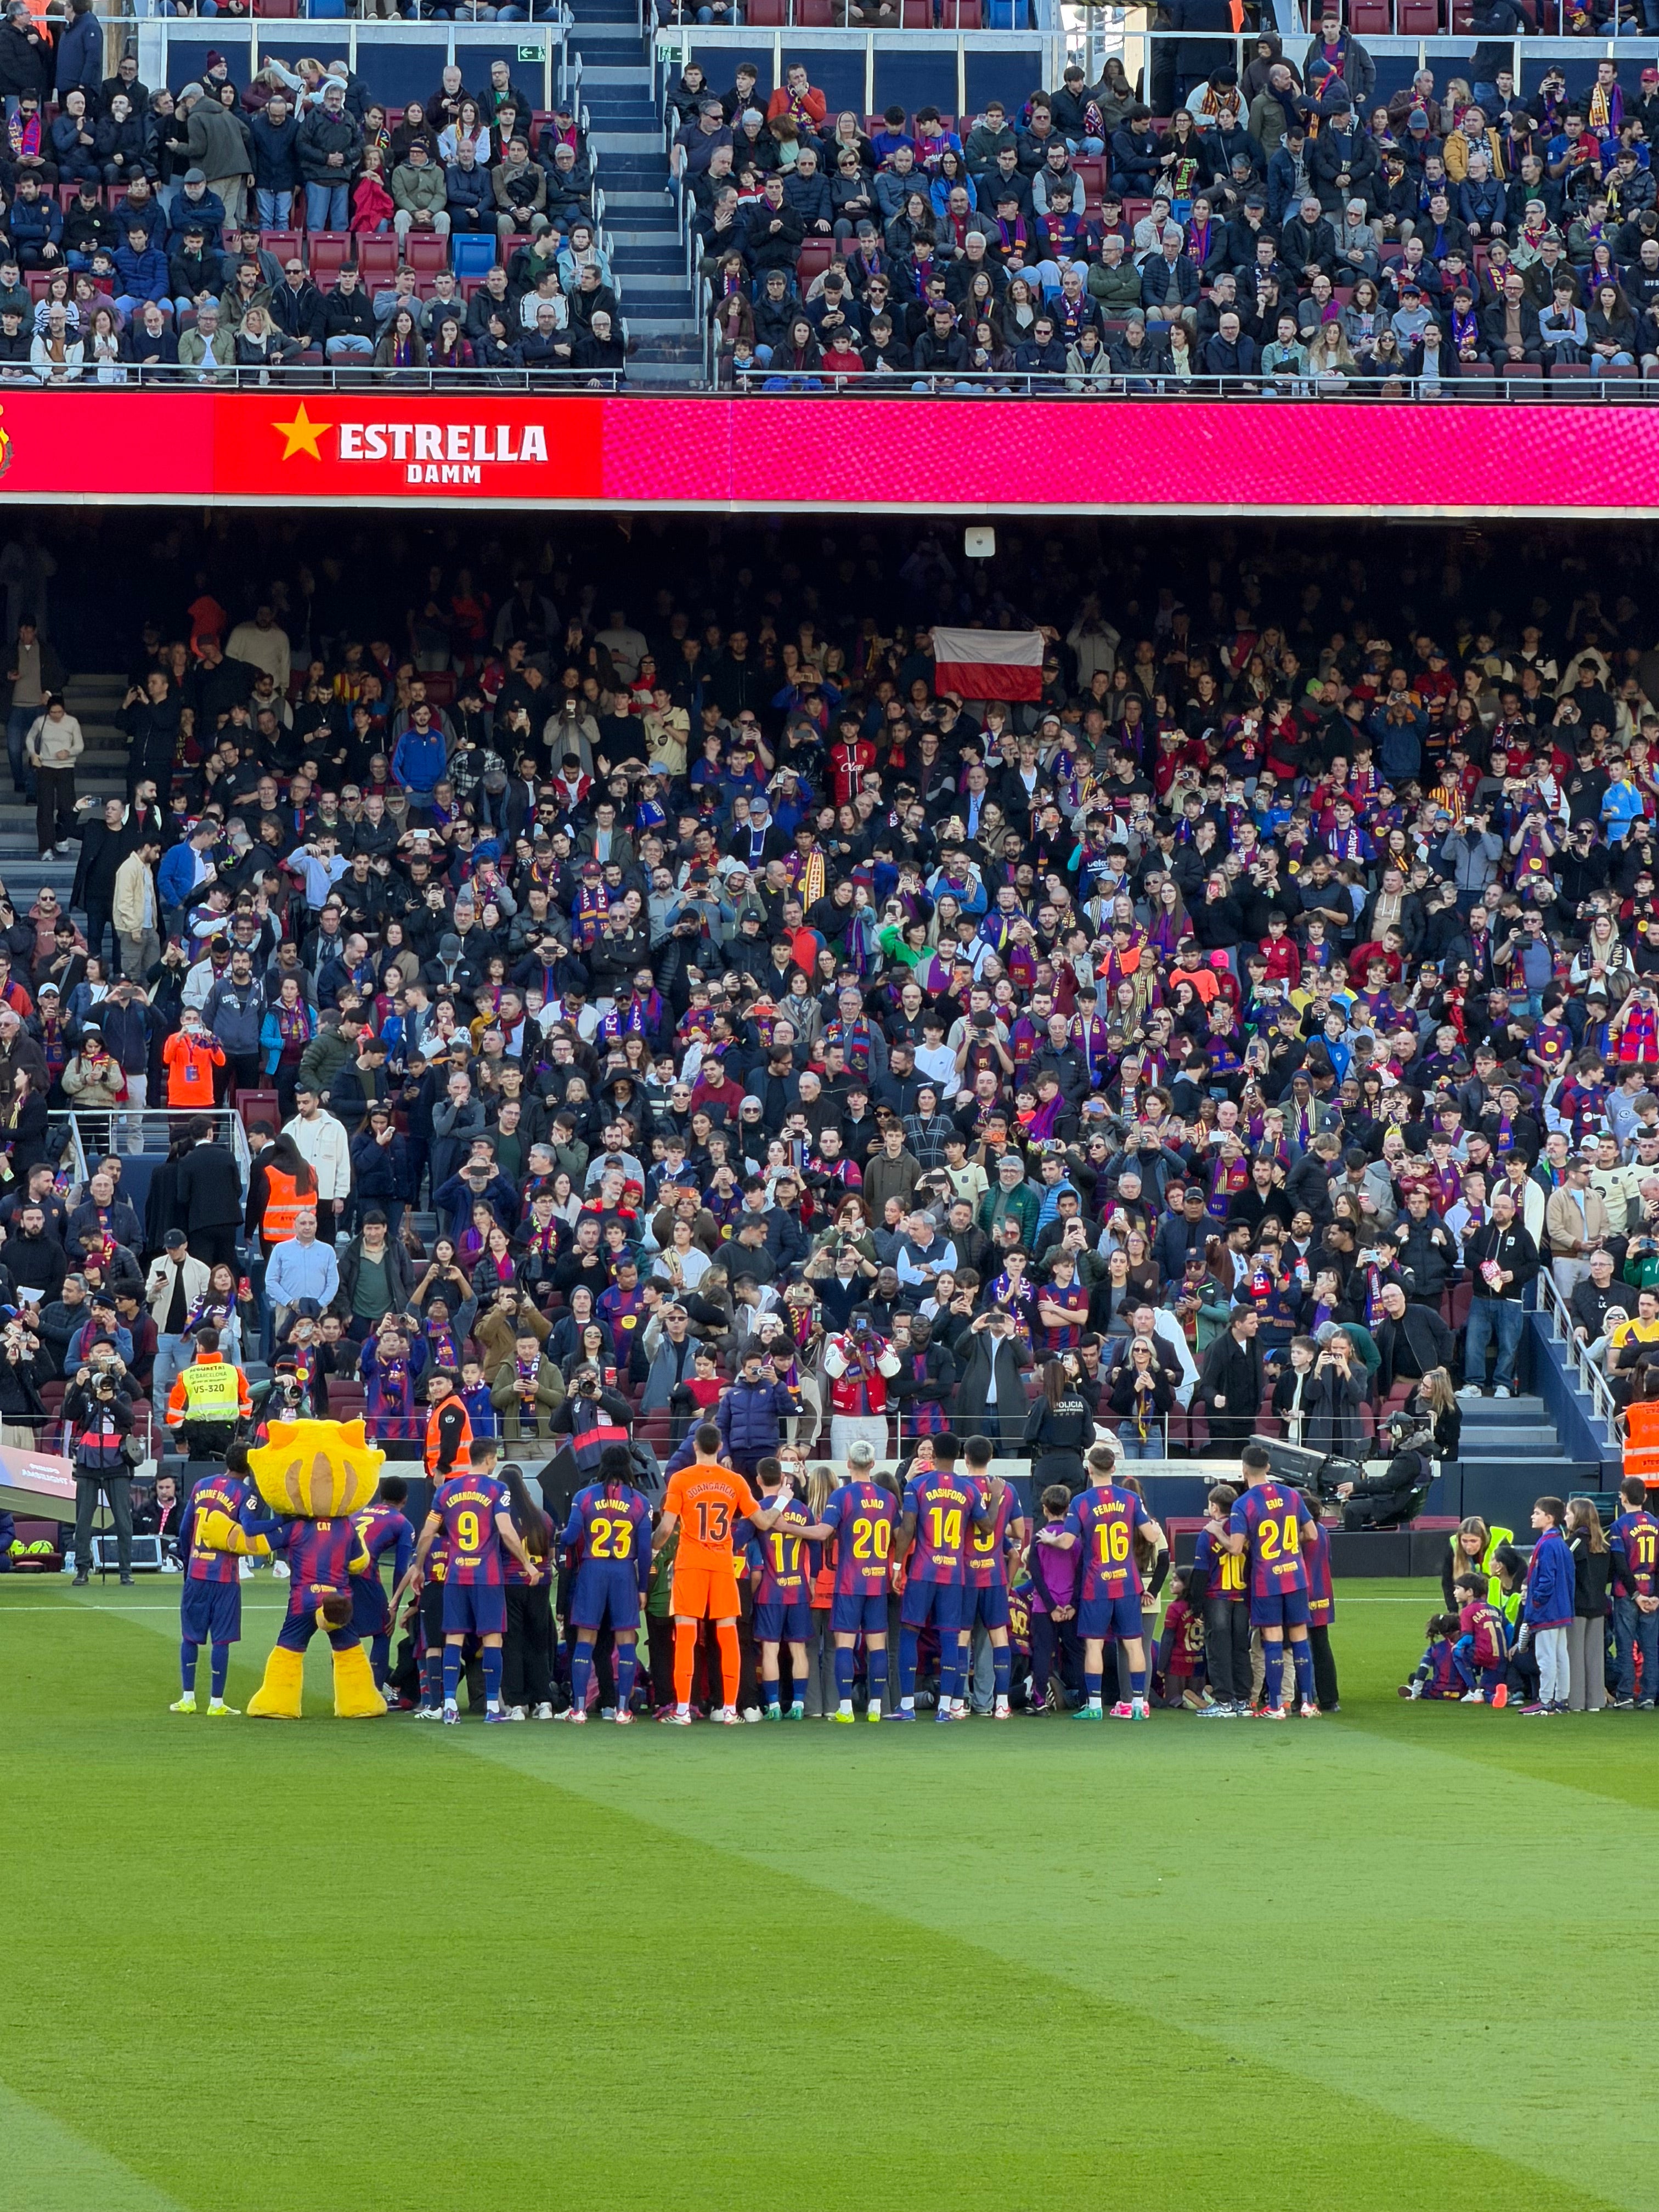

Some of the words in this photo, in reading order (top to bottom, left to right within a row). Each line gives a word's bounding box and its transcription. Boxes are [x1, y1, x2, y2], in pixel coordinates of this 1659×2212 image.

[339, 424, 548, 462] ESTRELLA
[405, 464, 481, 484] DAMM
[194, 1384, 225, 1394] VS-320
[216, 1491, 236, 1513] YAMAL
[445, 1490, 492, 1508] LEWANDOWSKI
[860, 1498, 884, 1510] OLMO
[925, 1488, 967, 1505] RASHFORD
[1092, 1500, 1126, 1517] FERMÍN
[1266, 1497, 1284, 1510] ERIC
[317, 1522, 331, 1532] CAT
[695, 1502, 730, 1542] 13
[783, 1511, 808, 1526] SADÓ
[929, 1507, 962, 1550] 14
[458, 1511, 479, 1551] 9
[590, 1517, 634, 1559] 23
[853, 1518, 891, 1559] 20
[1094, 1521, 1128, 1564] 16
[1258, 1515, 1300, 1560] 24
[769, 1532, 803, 1573] 17
[1637, 1536, 1655, 1563] 11
